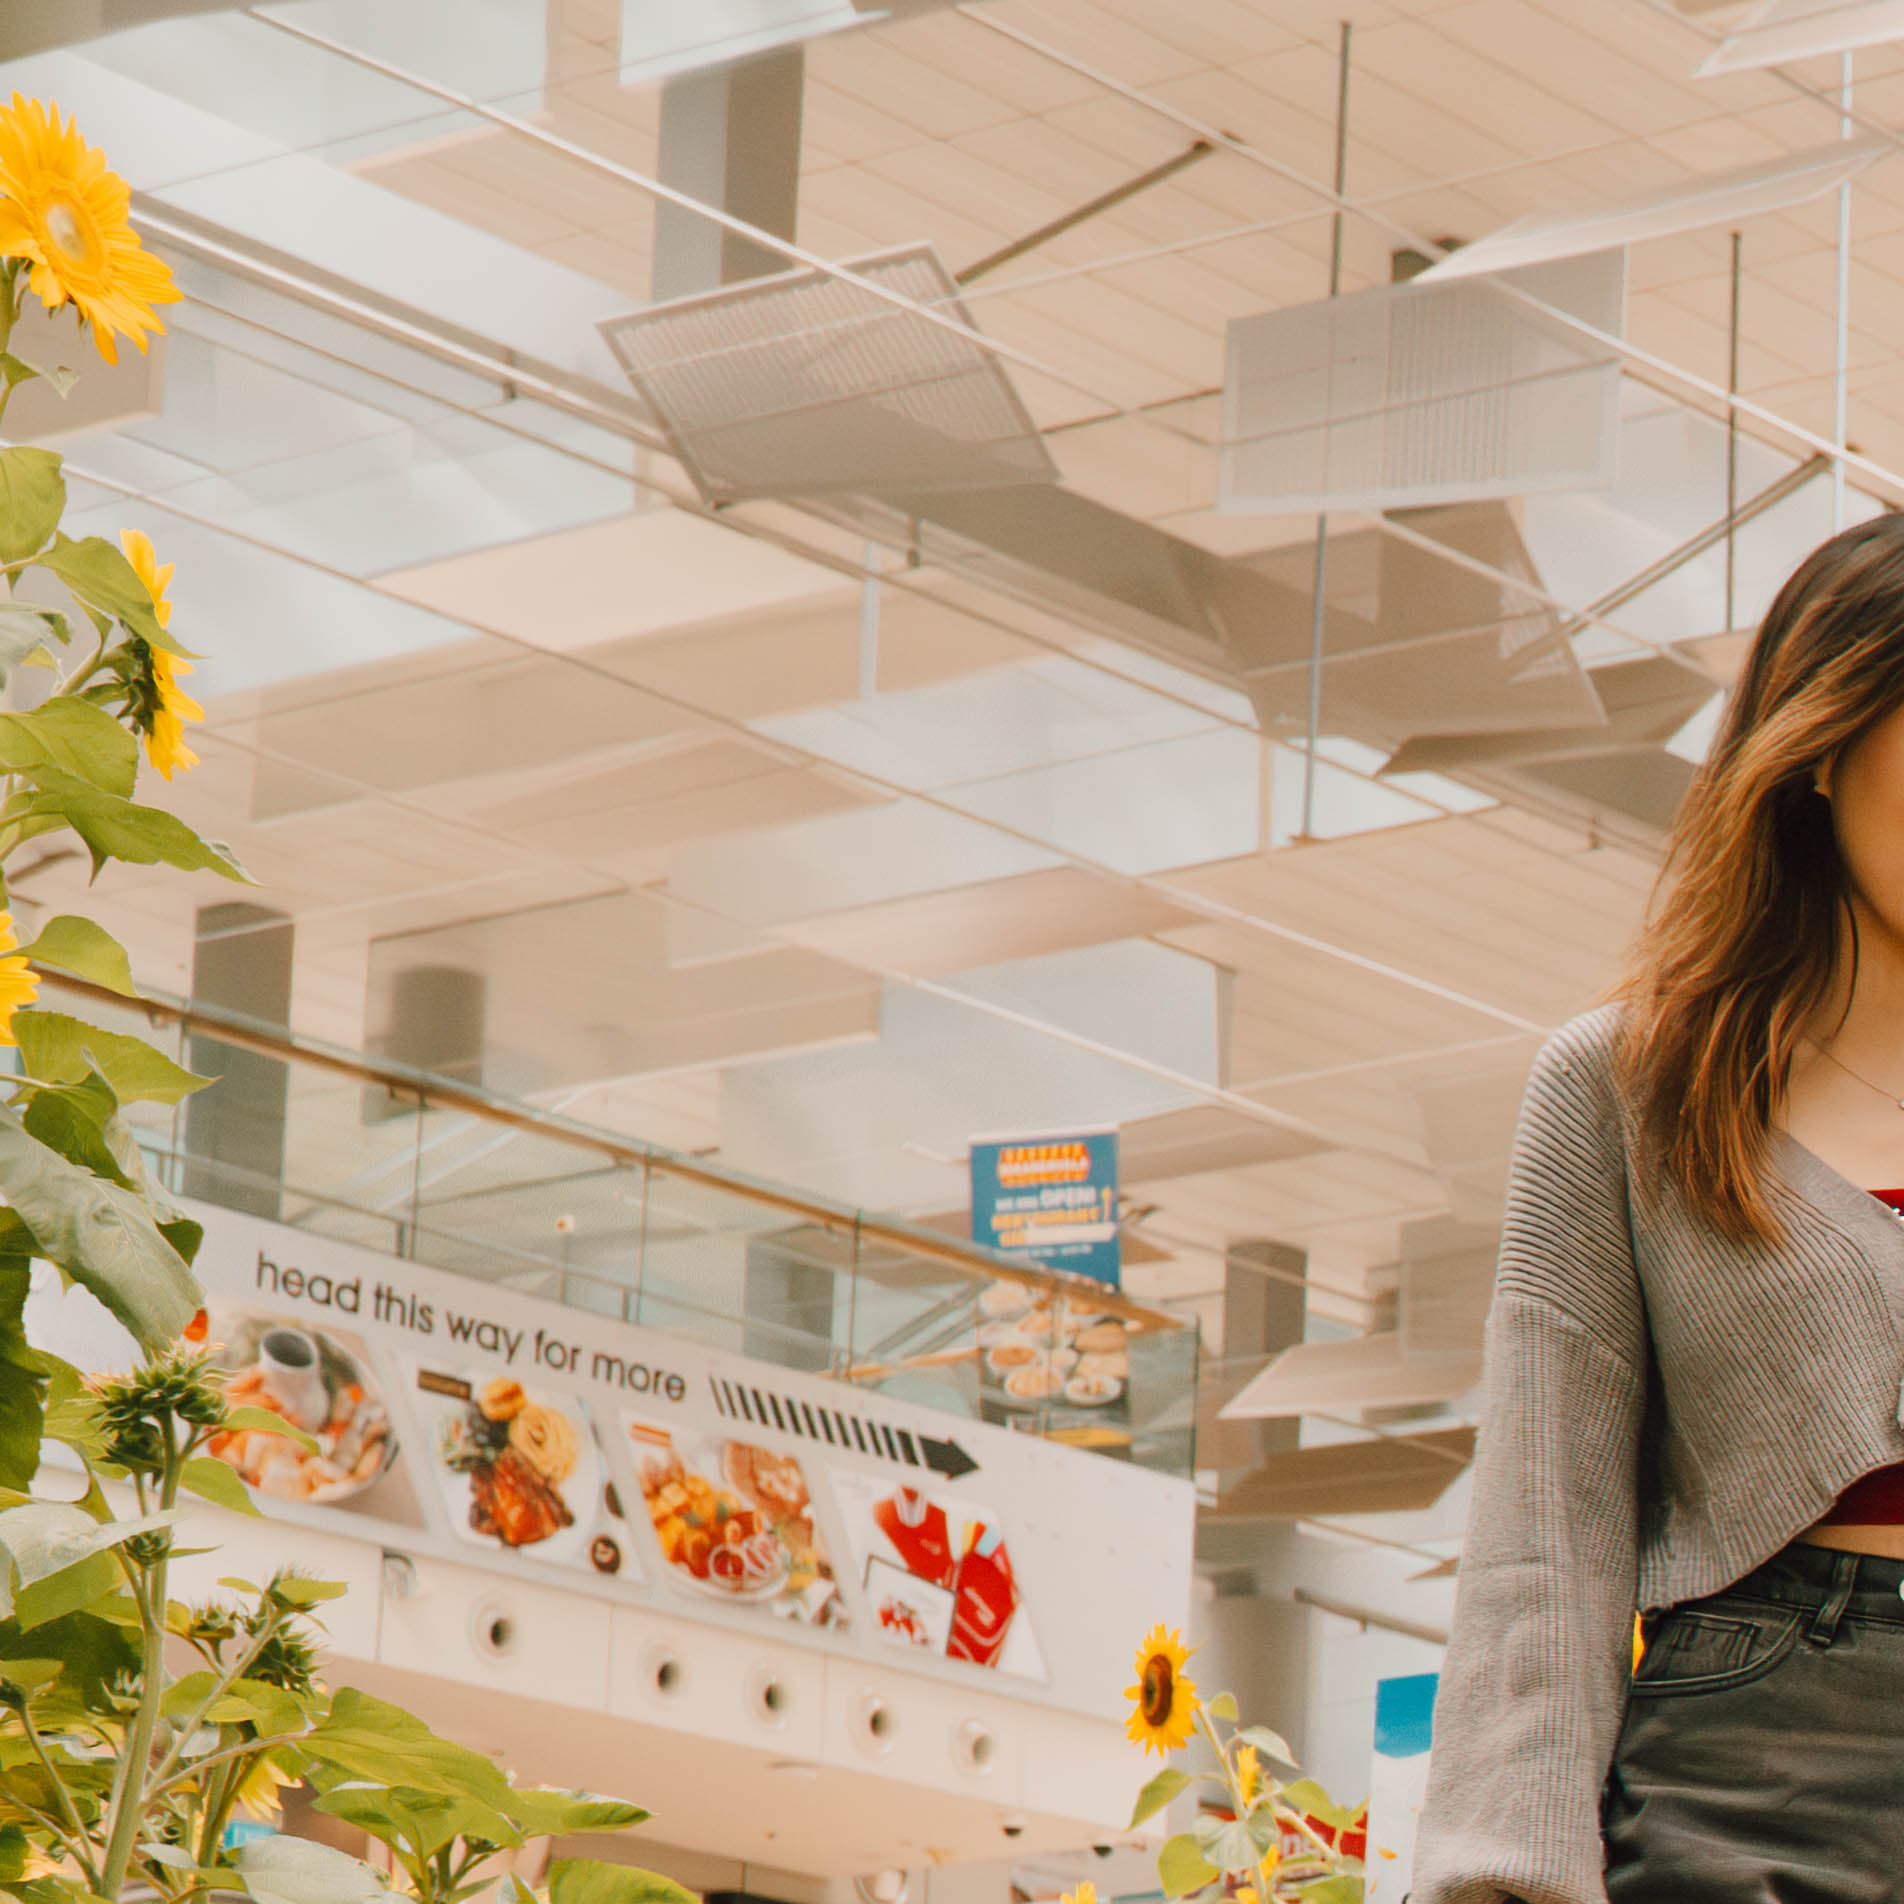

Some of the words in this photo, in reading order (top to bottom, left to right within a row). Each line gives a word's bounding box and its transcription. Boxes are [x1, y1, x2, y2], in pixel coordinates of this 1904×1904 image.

[256, 1251, 361, 1315] head
[373, 1282, 434, 1335] this
[446, 1310, 523, 1365] way
[533, 1329, 582, 1373] for
[592, 1353, 687, 1402] more
